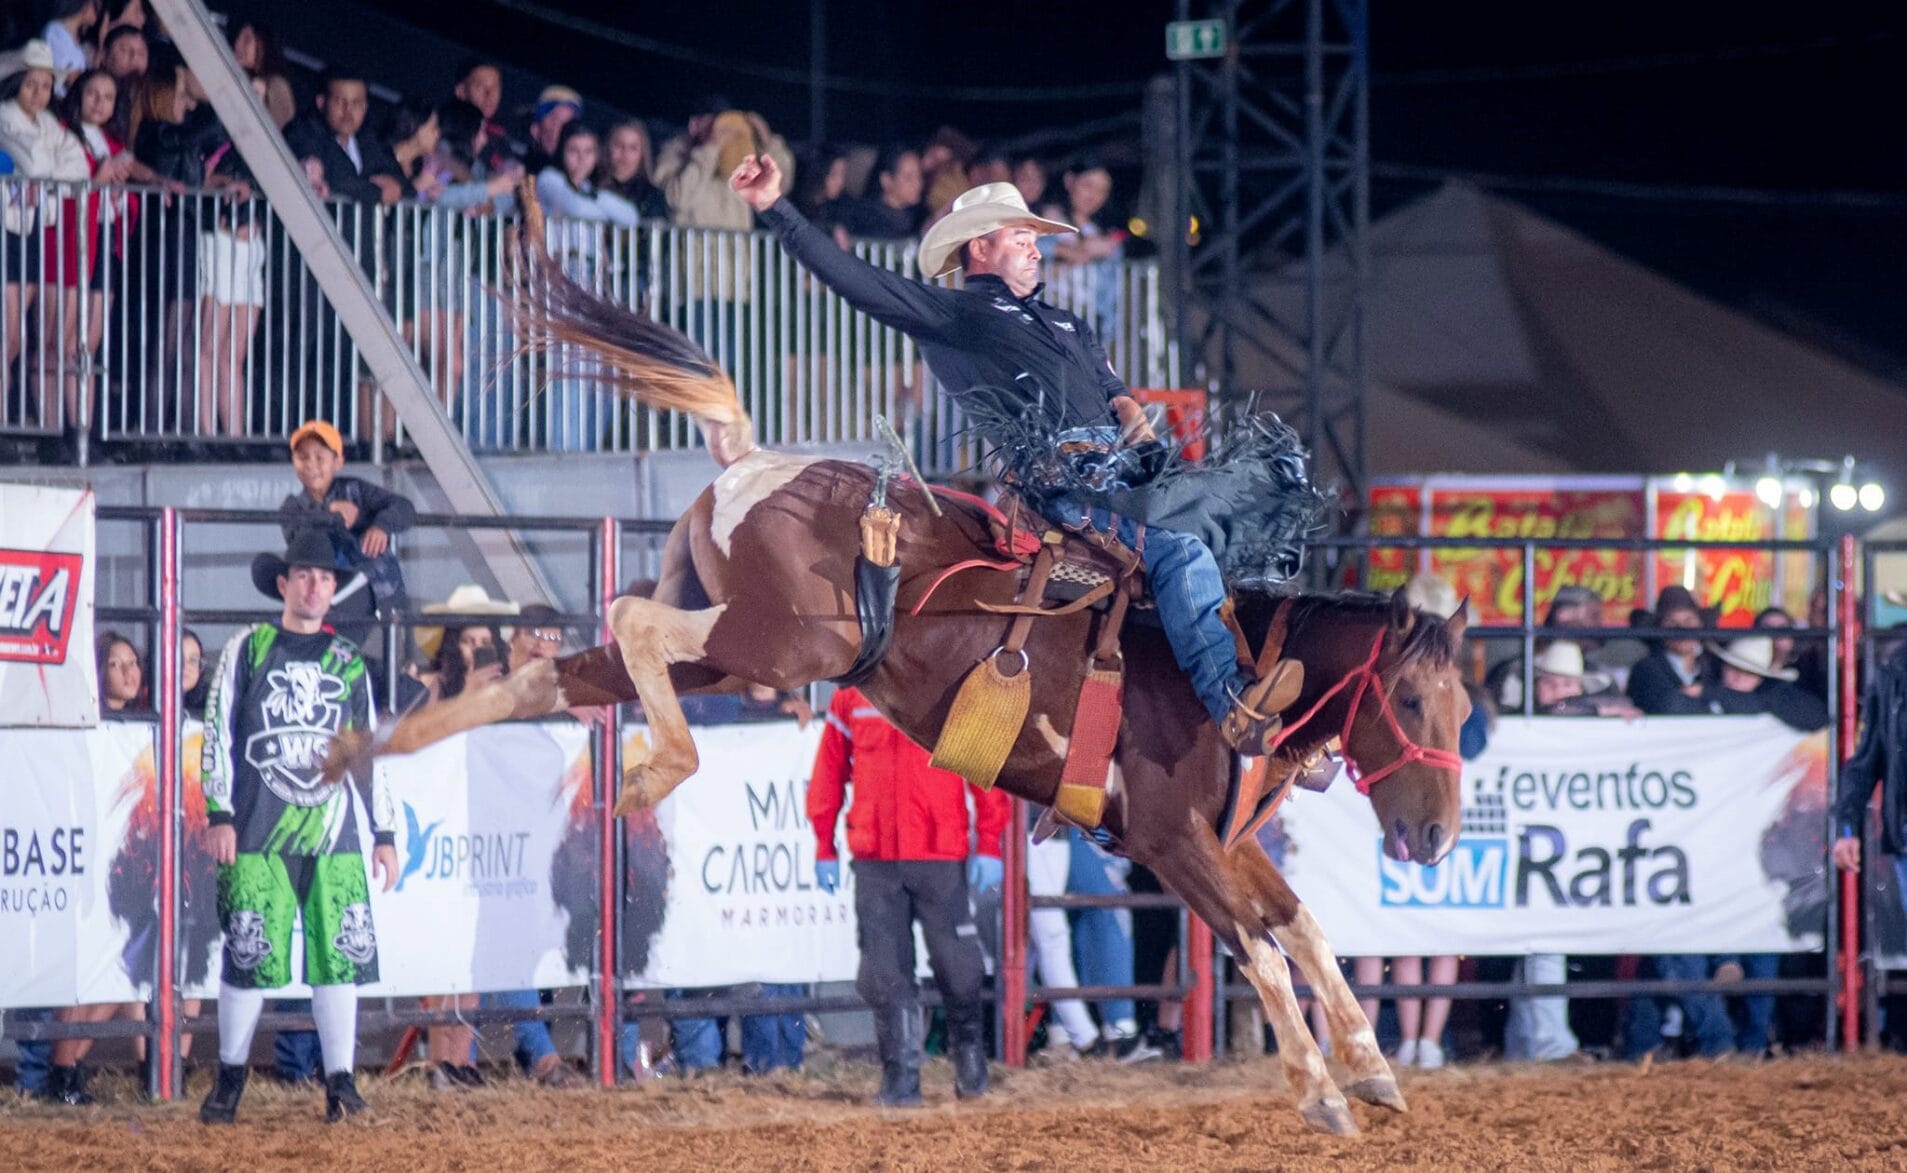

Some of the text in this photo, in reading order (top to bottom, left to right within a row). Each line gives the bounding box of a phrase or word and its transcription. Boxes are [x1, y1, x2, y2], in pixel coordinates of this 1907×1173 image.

[745, 780, 808, 830] MA
[1512, 763, 1697, 811] eventos
[4, 827, 84, 876] BASE
[425, 832, 530, 879] JBPRINT
[702, 843, 851, 893] CAROL
[1382, 818, 1692, 908] SOM Rafa
[721, 904, 848, 928] MARMORAR
